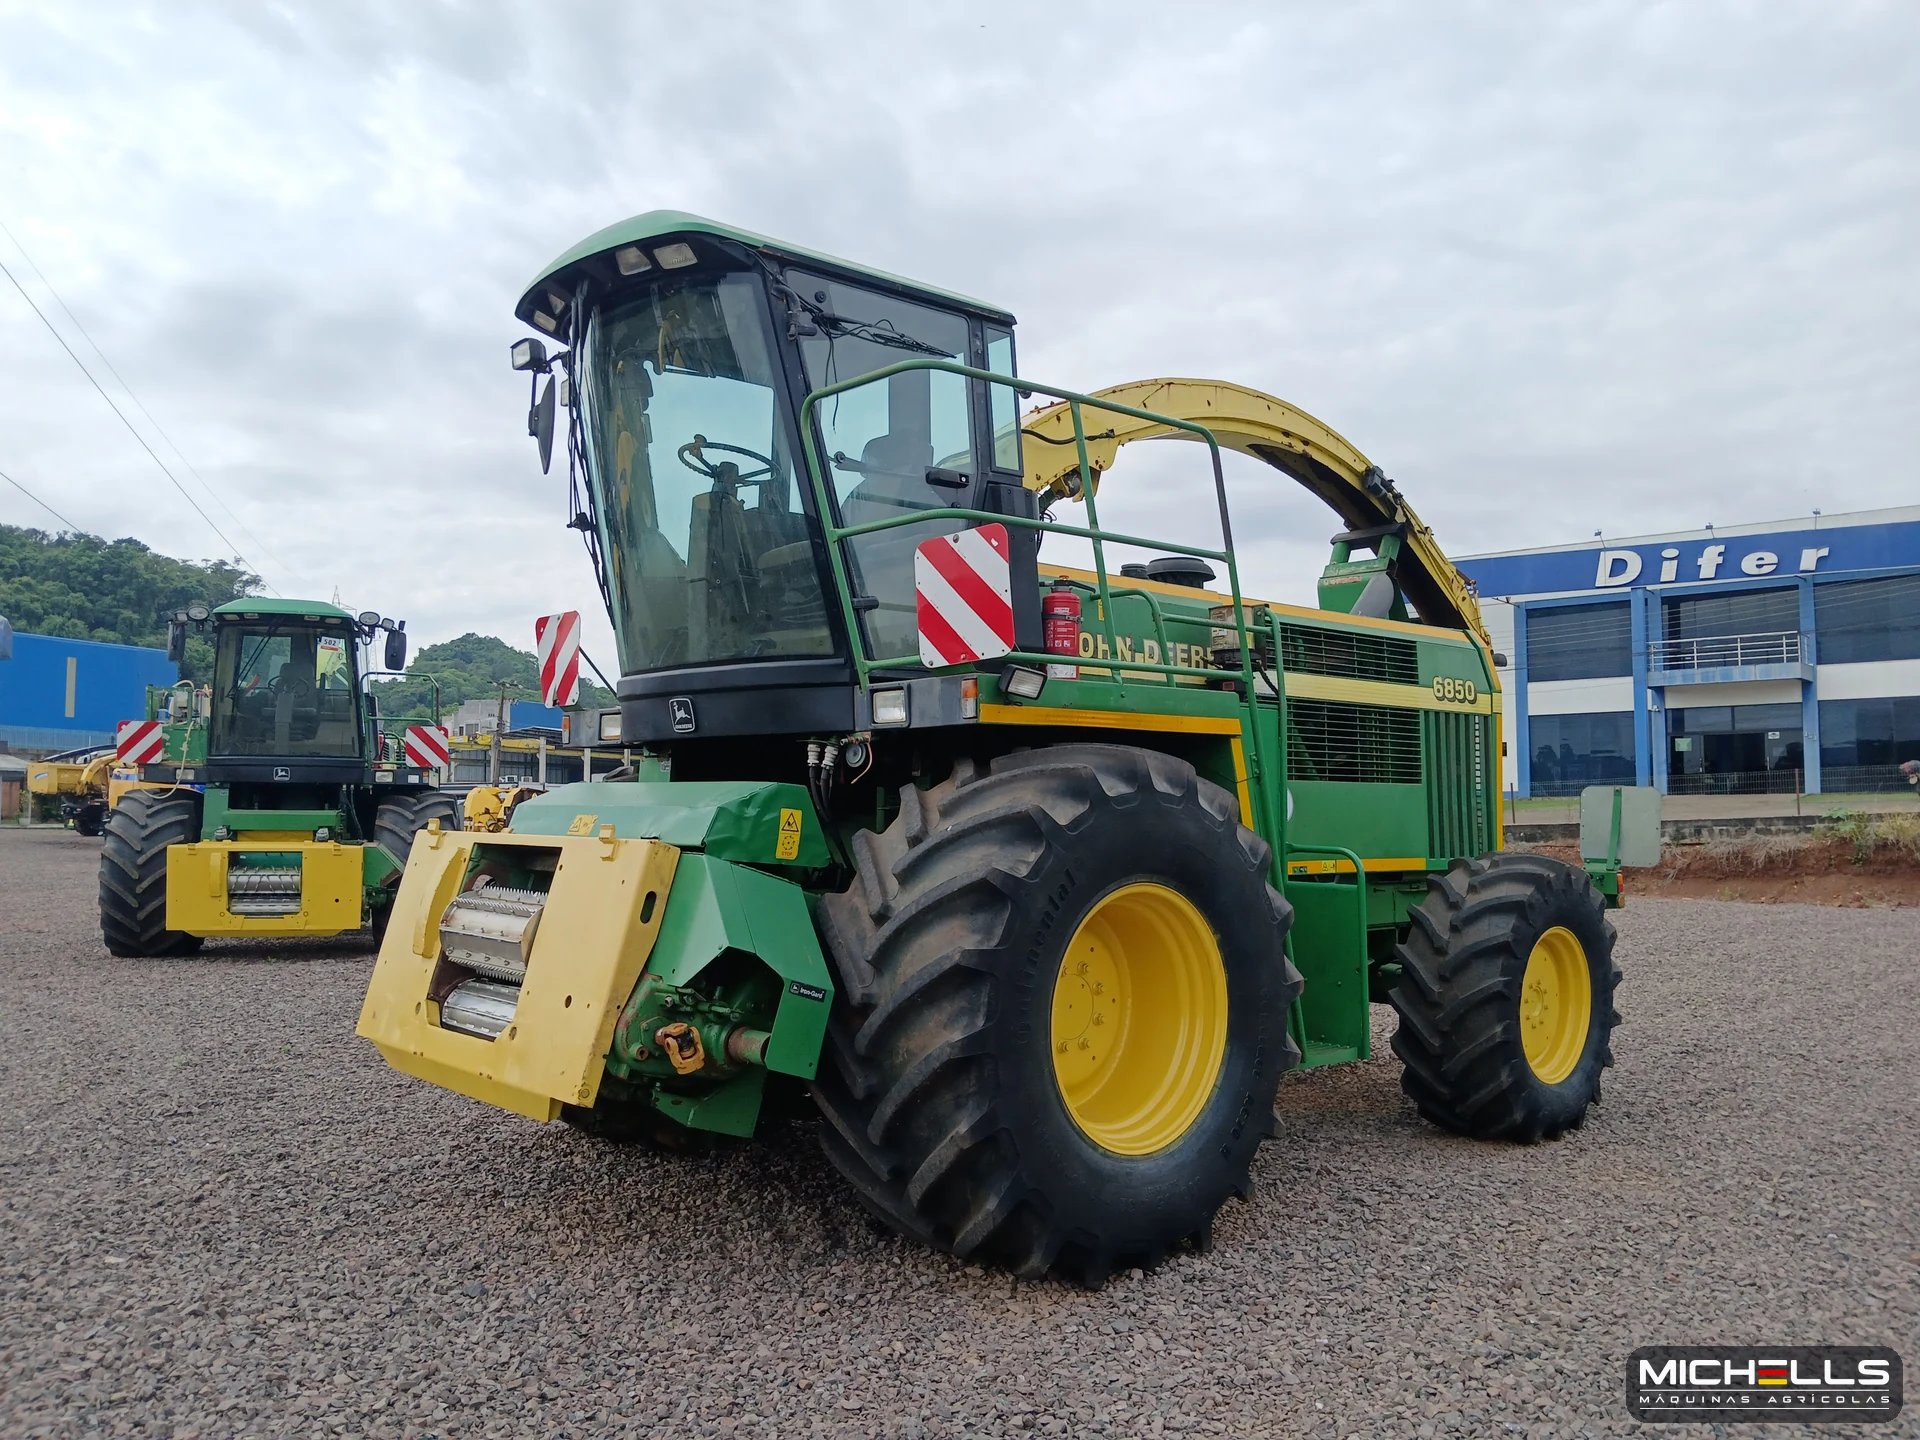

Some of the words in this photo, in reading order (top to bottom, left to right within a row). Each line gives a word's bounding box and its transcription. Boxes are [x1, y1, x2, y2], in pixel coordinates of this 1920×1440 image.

[1595, 544, 1829, 587] Difer
[1079, 632, 1133, 662] OHN
[1432, 676, 1477, 704] 6850
[799, 986, 824, 999] Iron-Gard
